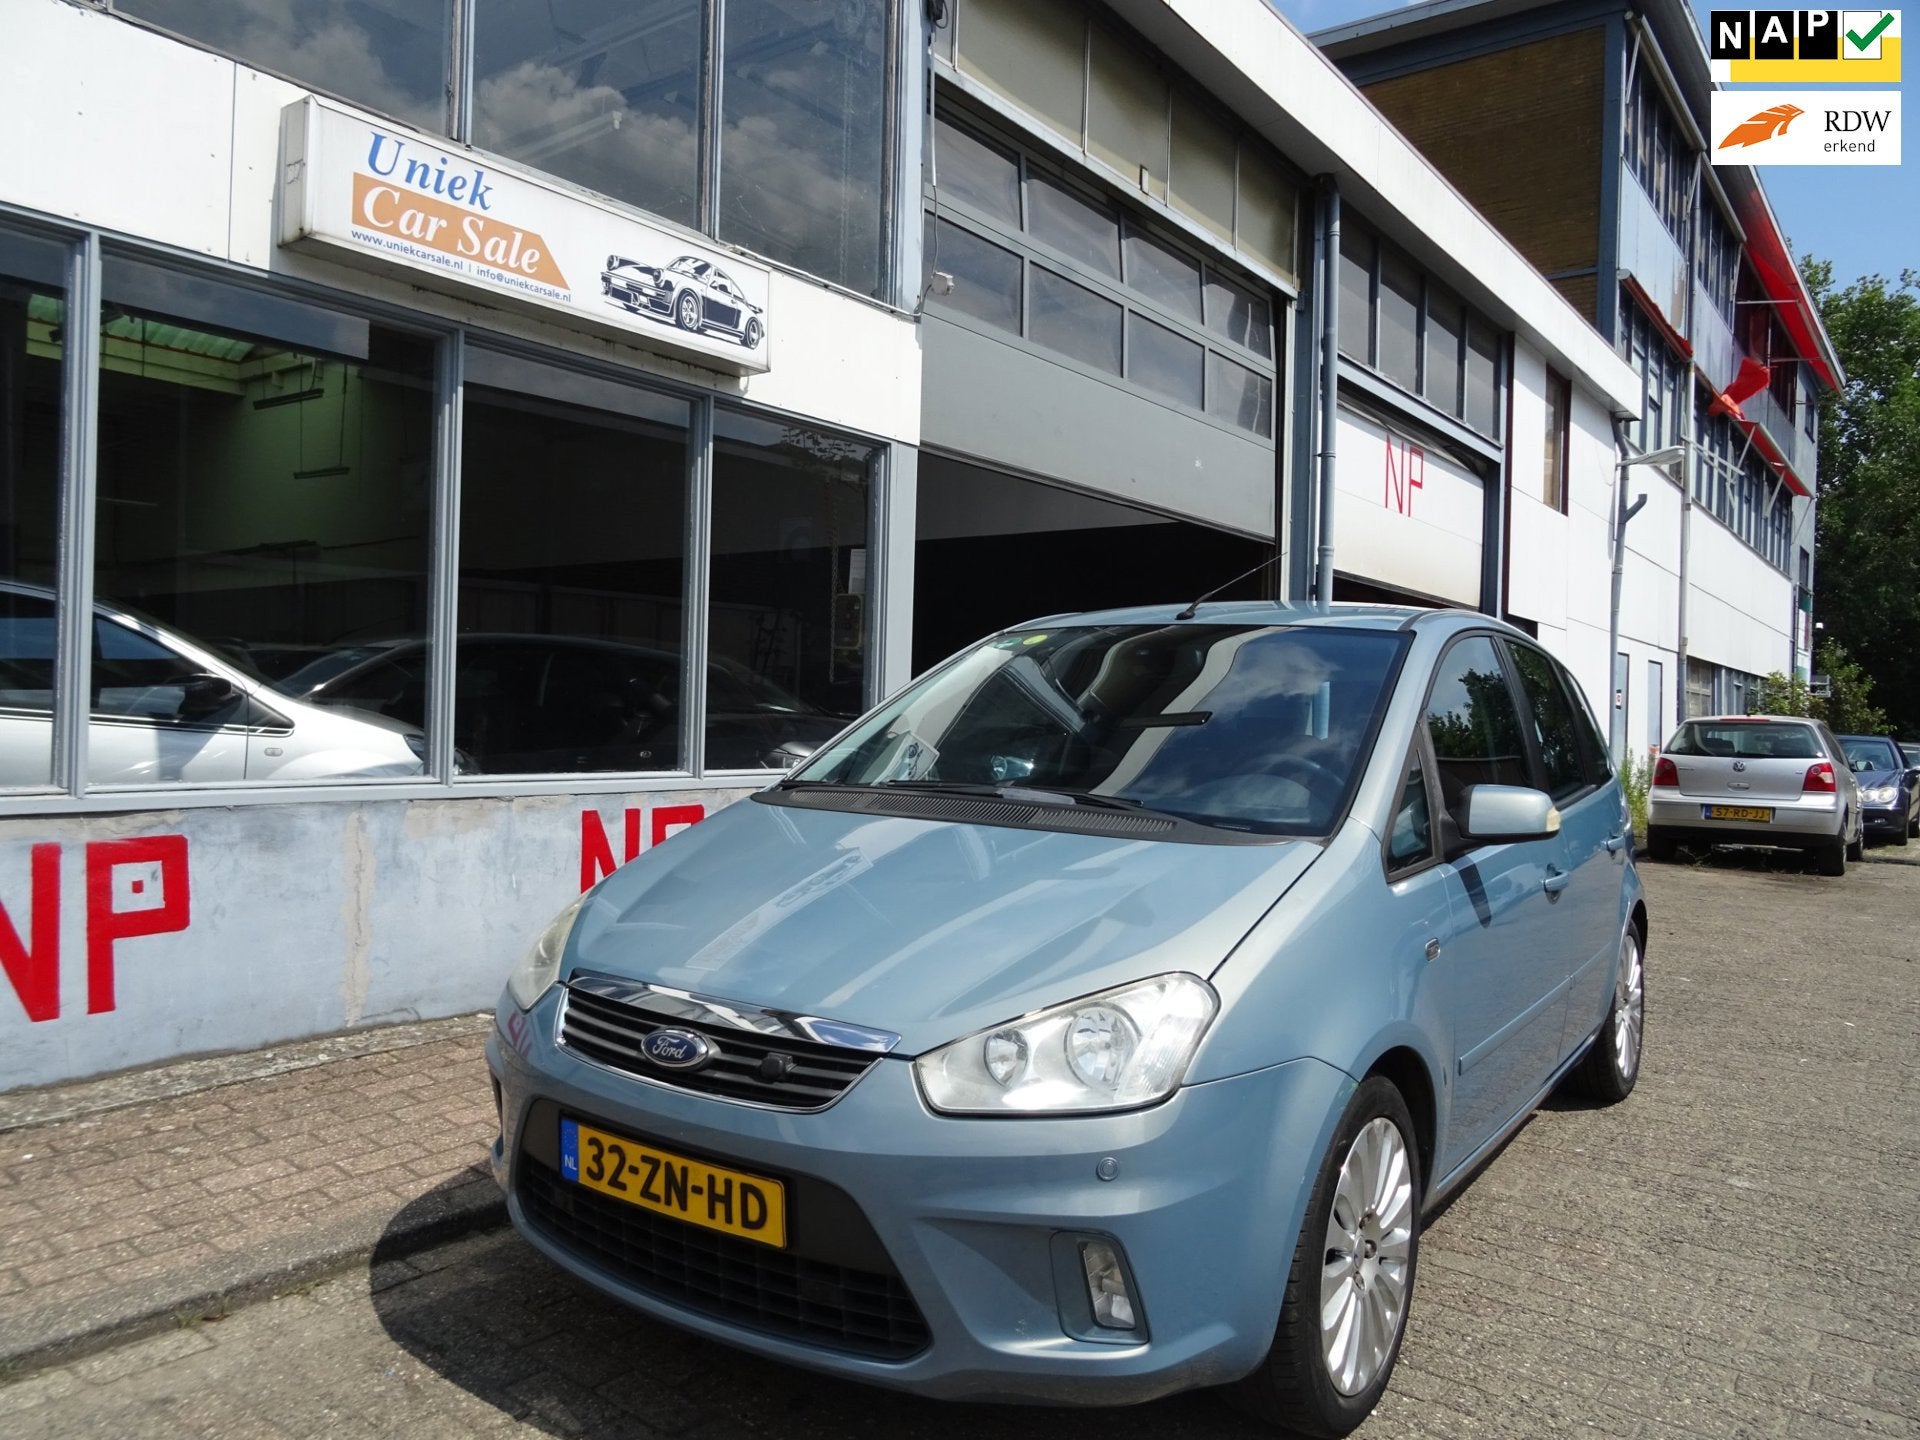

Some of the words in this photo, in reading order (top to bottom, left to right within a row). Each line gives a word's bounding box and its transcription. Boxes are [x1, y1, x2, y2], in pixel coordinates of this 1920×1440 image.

[367, 131, 494, 211] Uniek
[351, 229, 464, 271] www.uniekcarsale.nl
[476, 265, 572, 303] info@uniekcarsale.nl
[363, 186, 448, 243] Car
[456, 217, 541, 275] Sale
[1385, 433, 1424, 517] NP
[652, 1035, 688, 1060] Ford
[564, 1154, 577, 1171] NL
[586, 1137, 768, 1231] 32-ZN-HD
